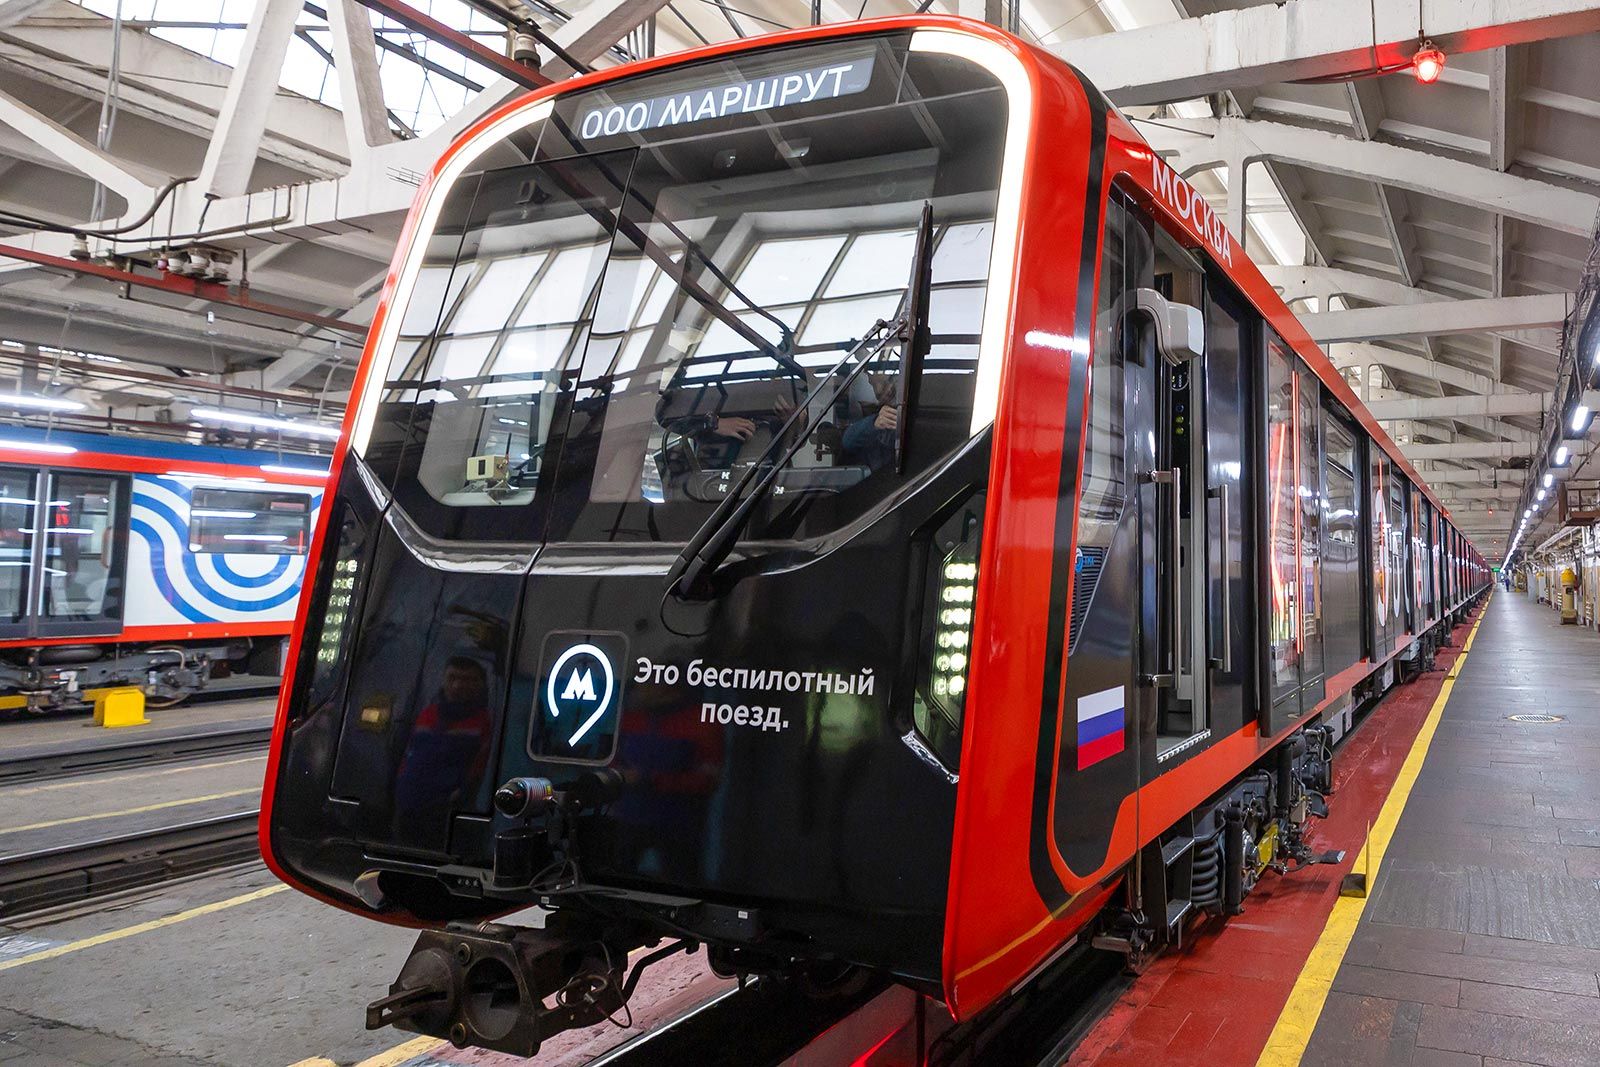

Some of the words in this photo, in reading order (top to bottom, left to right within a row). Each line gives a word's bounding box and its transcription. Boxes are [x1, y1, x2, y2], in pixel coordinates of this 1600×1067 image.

[658, 64, 853, 127] МАРШРУТ
[1152, 153, 1233, 268] МОСКВА
[634, 657, 680, 685] Это
[686, 658, 875, 696] беспилотный
[701, 702, 789, 732] поезд.
